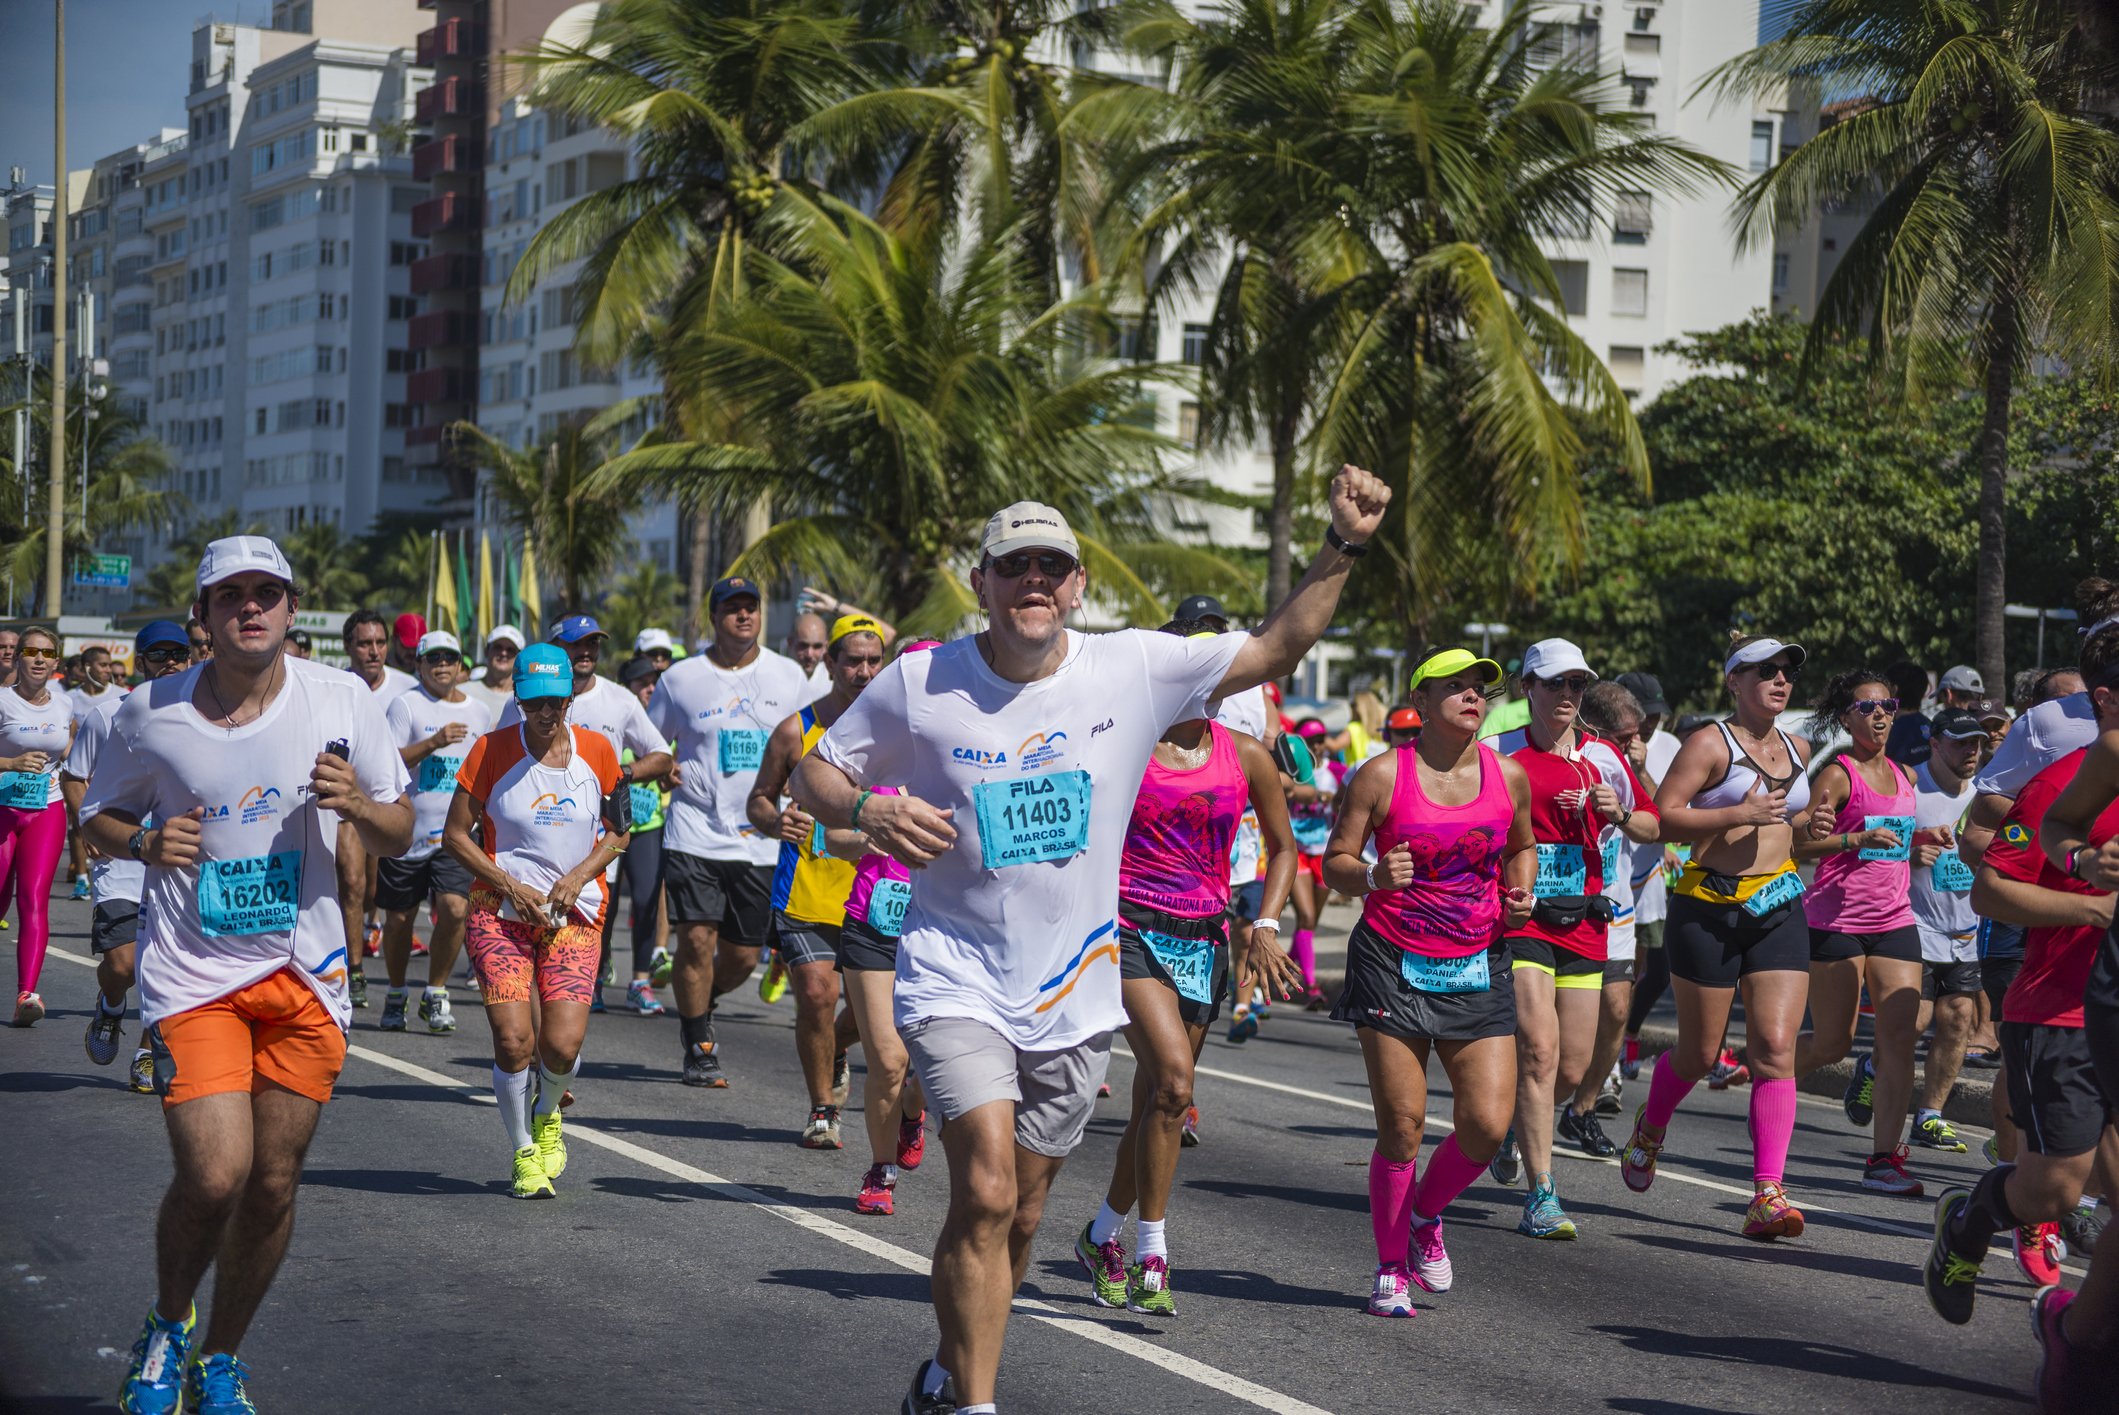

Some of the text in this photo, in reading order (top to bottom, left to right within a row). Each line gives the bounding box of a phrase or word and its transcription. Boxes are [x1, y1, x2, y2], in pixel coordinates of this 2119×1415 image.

[1021, 519, 1058, 527] HELIBRAS
[535, 663, 560, 673] MILHAS
[699, 707, 723, 719] CAIXA
[602, 724, 615, 733] FILA
[1091, 718, 1114, 738] FILA
[732, 731, 752, 739] FILA
[727, 741, 758, 755] 16169
[1023, 749, 1054, 760] MARATONA
[952, 747, 1007, 764] CAIXA
[1022, 752, 1064, 766] INTERNACIONAL
[18, 773, 36, 781] FILA
[13, 782, 41, 795] 10027
[1010, 778, 1055, 798] FILA
[242, 808, 278, 819] INTERNACIONAL
[243, 803, 269, 813] MARATONA
[1003, 797, 1072, 830] 11403
[1883, 818, 1902, 827] FILA
[1013, 828, 1066, 844] MARCOS
[1001, 841, 1077, 860] CAIXA BRASIL
[1536, 845, 1567, 855] AIXA
[220, 856, 283, 876] CAIXA
[221, 880, 291, 910] 16202
[1128, 889, 1149, 902] MEIA
[1152, 894, 1200, 912] MARATONA
[1202, 899, 1212, 912] RIO
[223, 906, 290, 921] LEONARDO
[220, 916, 295, 931] CAIXA BRASIL
[878, 924, 900, 932] CAIXA
[1152, 936, 1198, 953] CAIXA
[1425, 968, 1465, 978] DANIELA
[1415, 977, 1441, 987] CAIXA
